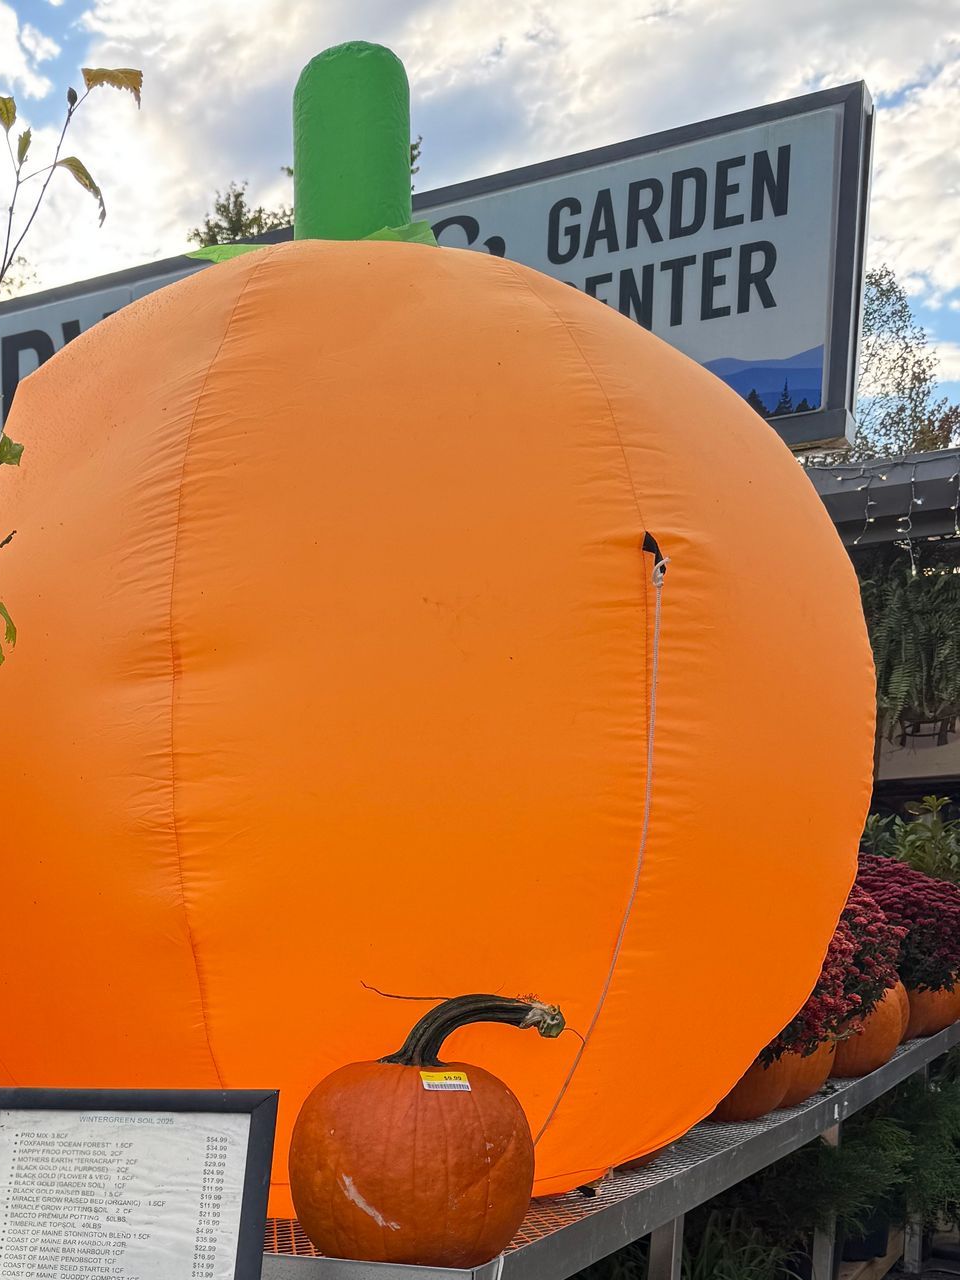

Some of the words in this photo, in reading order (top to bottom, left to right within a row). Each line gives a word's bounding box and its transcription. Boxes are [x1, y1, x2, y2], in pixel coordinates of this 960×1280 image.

[547, 144, 791, 265] GARDEN
[563, 240, 777, 331] NTER
[80, 1116, 135, 1124] WINTERGREEN
[38, 1172, 56, 1180] GOLD
[14, 1179, 35, 1187] BLACK
[13, 1187, 34, 1195] BLACK
[81, 1189, 94, 1197] BED
[12, 1195, 39, 1203] MIRACLE
[41, 1196, 62, 1204] GROW
[64, 1197, 88, 1205] RAISED
[63, 1205, 92, 1213] POTTING
[94, 1206, 108, 1214] SOIL
[38, 1213, 68, 1221] PREMIUM
[70, 1214, 99, 1222] POTTING
[10, 1220, 47, 1228] TIMBERLINE
[49, 1221, 76, 1229] TOPSOIL
[8, 1228, 29, 1236] COAST
[42, 1229, 62, 1237] MAINE
[64, 1230, 107, 1238] STONINGTON
[7, 1236, 28, 1244] COAST
[41, 1237, 61, 1245] MAINE
[63, 1238, 76, 1246] BAR
[78, 1239, 111, 1247] HARBOUR
[29, 1245, 38, 1253] OF
[77, 1247, 110, 1255] HARBOUR
[4, 1253, 26, 1261] COAST
[39, 1254, 59, 1262] MAINE
[61, 1255, 101, 1264] PENOBSCOT
[3, 1261, 24, 1269] COAST
[27, 1262, 35, 1270] OF
[37, 1263, 58, 1271] MAINE
[60, 1264, 77, 1272] SEED
[80, 1265, 110, 1273] STARTER
[2, 1270, 23, 1278] COAST
[36, 1271, 56, 1279] MAINE
[61, 1273, 88, 1280] QUODDY
